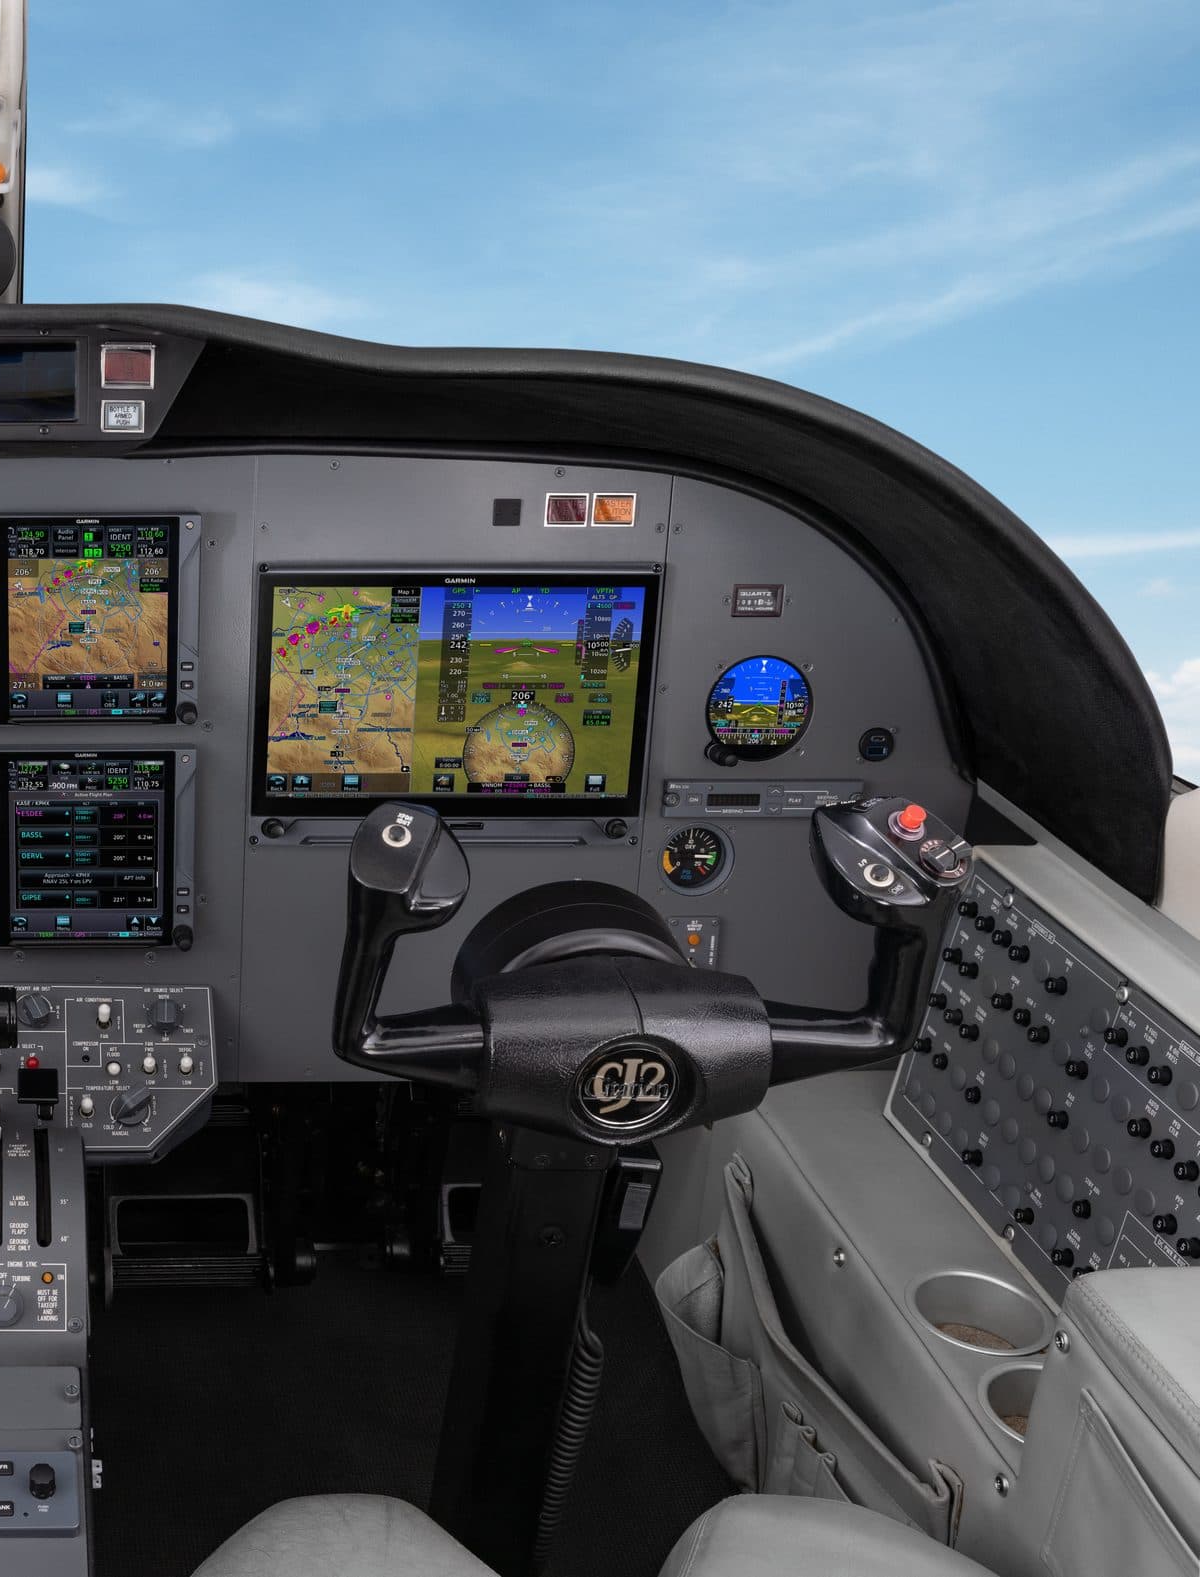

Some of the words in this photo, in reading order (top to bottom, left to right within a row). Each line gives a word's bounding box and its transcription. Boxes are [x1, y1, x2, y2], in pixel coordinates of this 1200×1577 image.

[450, 641, 466, 649] 242
[512, 692, 534, 700] 206°
[107, 777, 128, 785] 5250
[593, 1058, 665, 1114] CJ2
